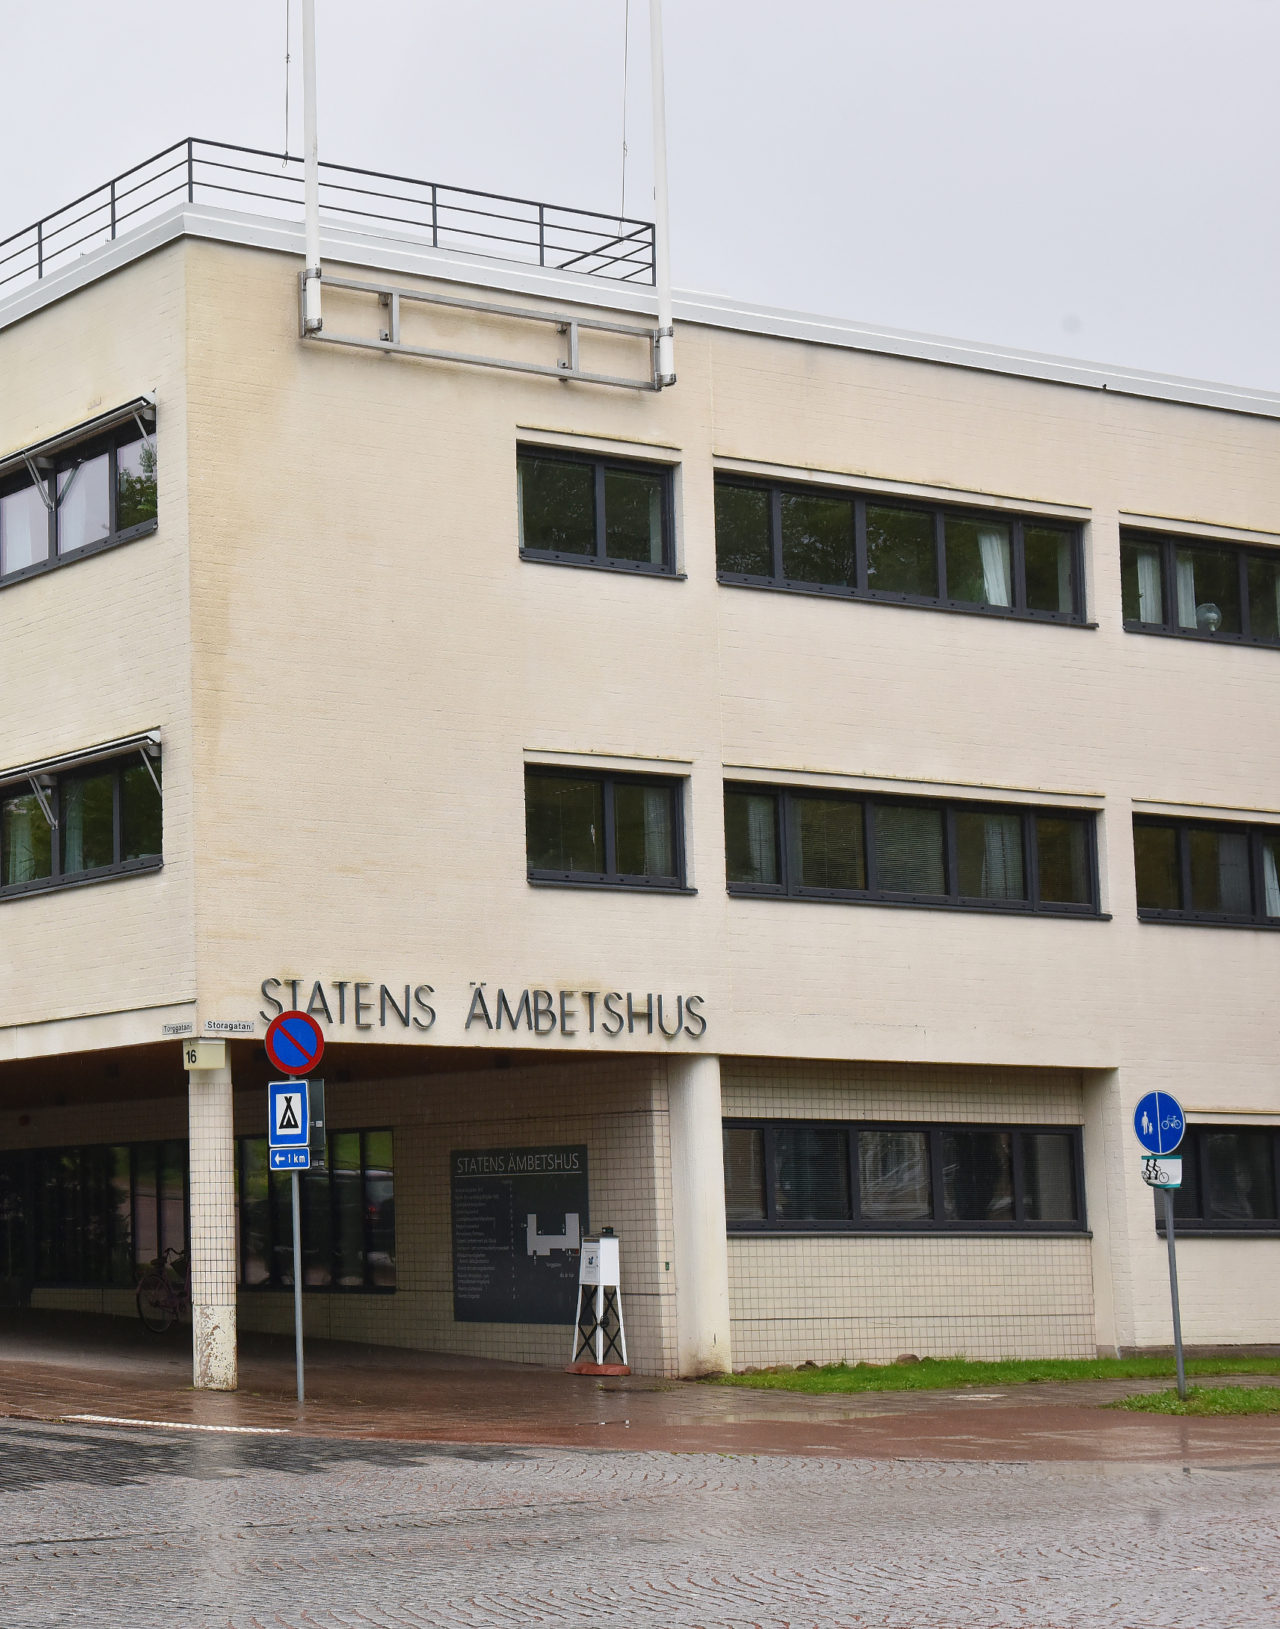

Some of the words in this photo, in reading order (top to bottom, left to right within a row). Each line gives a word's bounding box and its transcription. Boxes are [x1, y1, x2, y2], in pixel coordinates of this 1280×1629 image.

[259, 977, 436, 1029] STATENS
[465, 981, 708, 1039] ÄMBETSHUS
[164, 1024, 191, 1034] Torggatan
[207, 1021, 251, 1031] Storagatan
[185, 1049, 197, 1064] 16
[288, 1153, 291, 1164] 1
[293, 1153, 306, 1164] km
[456, 1155, 505, 1173] STATENS
[507, 1152, 579, 1171] ÄMBETSHUS
